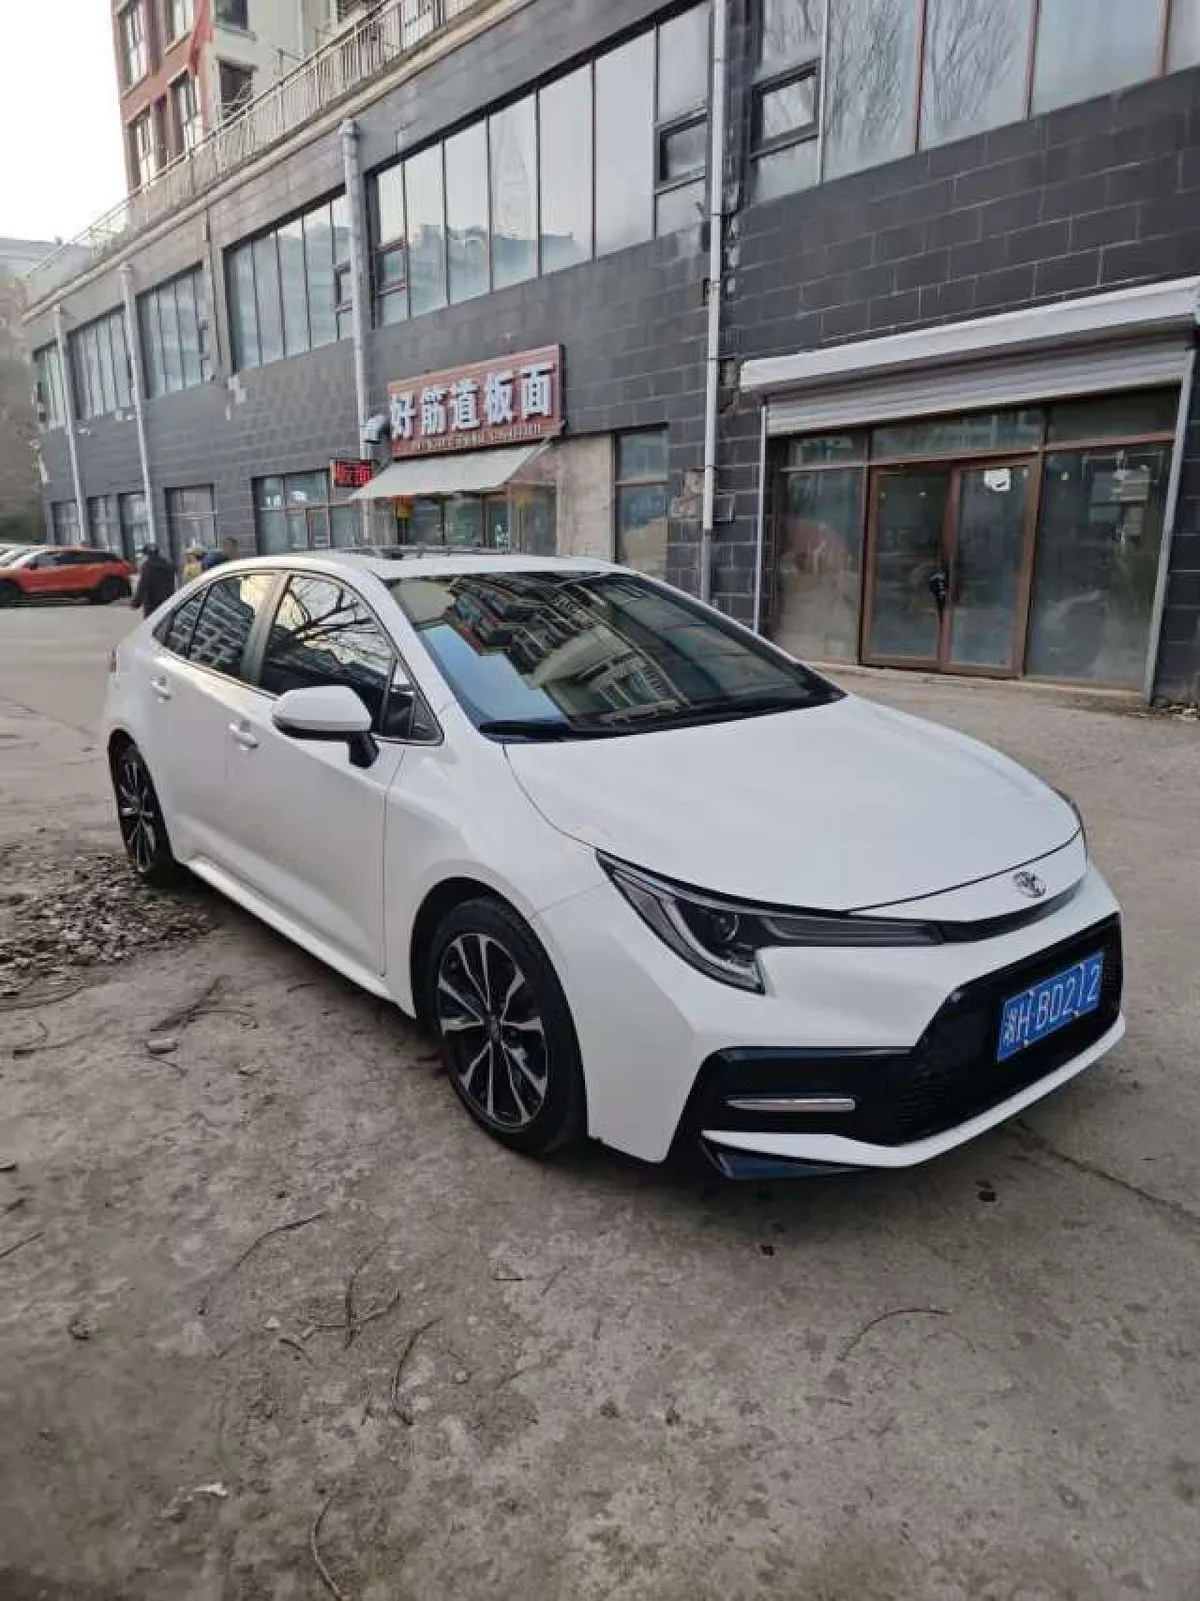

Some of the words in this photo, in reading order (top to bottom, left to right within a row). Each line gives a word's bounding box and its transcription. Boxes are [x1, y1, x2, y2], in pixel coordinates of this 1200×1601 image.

[389, 362, 556, 440] 好筋道板面
